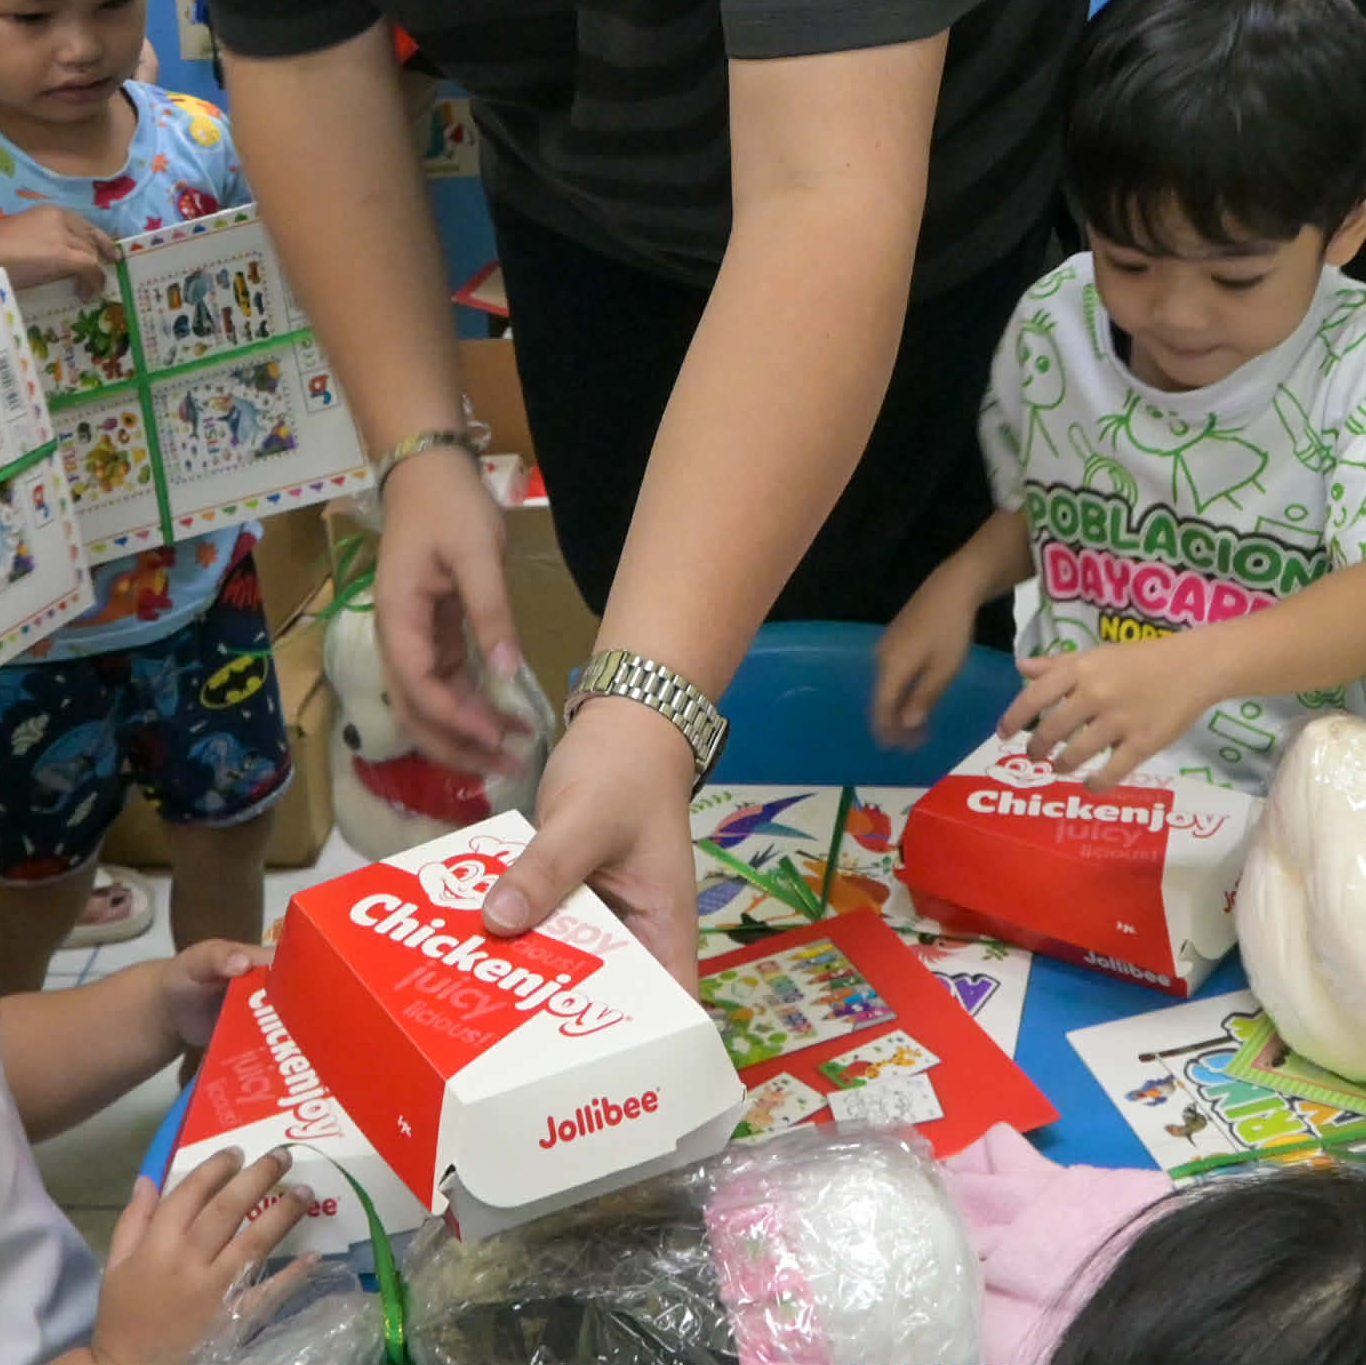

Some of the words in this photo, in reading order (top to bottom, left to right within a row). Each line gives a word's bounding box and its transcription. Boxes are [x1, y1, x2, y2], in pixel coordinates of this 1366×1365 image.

[1047, 544, 1280, 623] DAYCAR
[967, 790, 1229, 838] Chickenjoy
[349, 893, 625, 1037] Chickenjoy
[394, 959, 508, 1021] juicy
[1084, 950, 1172, 987] Jollibee
[403, 999, 494, 1047] licious!
[538, 1090, 657, 1151] Jollibee
